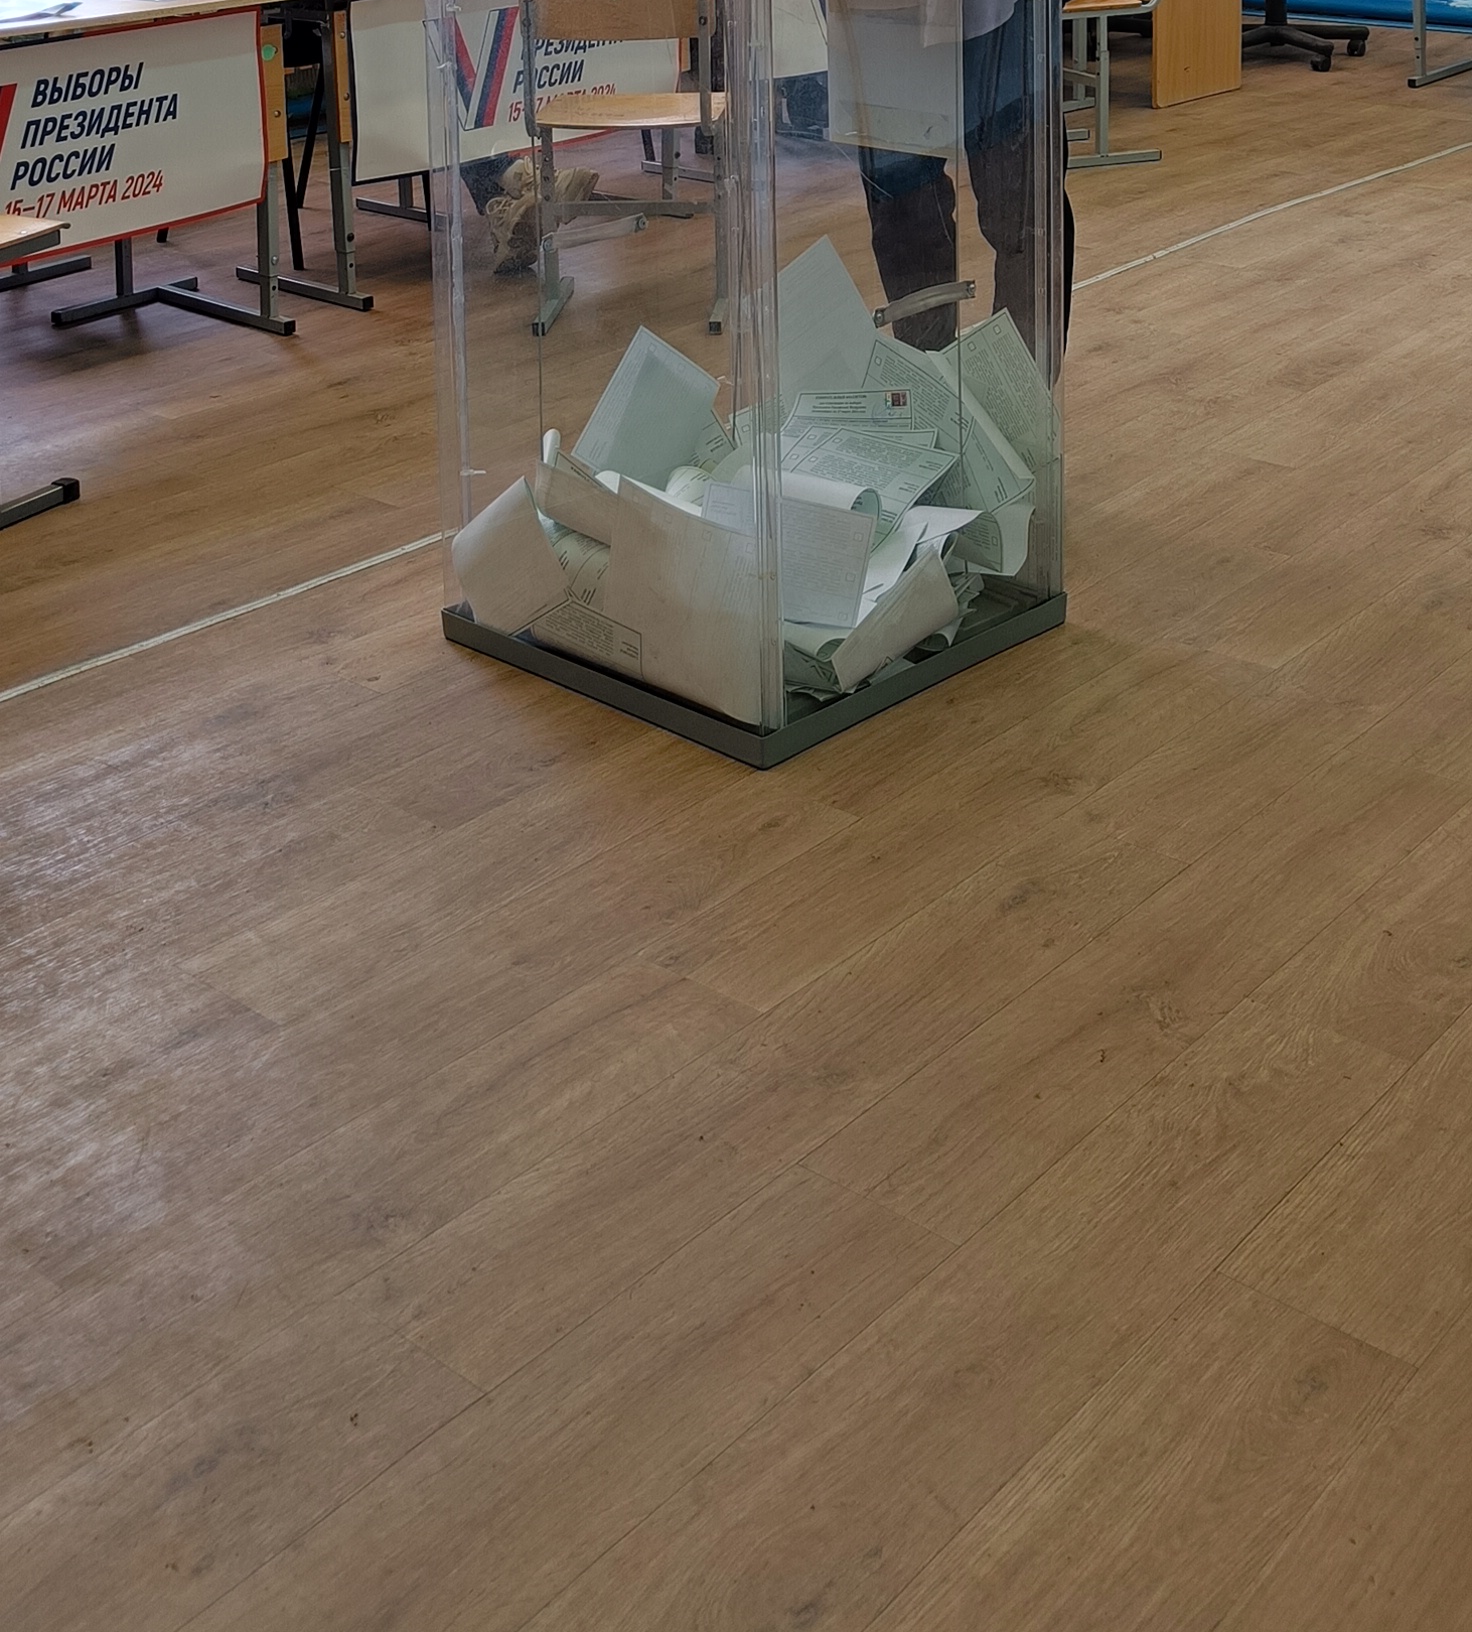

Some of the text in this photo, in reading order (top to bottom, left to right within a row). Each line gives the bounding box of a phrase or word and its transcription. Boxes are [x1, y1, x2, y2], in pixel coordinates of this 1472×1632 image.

[31, 62, 144, 108] ВЫБОРЫ
[513, 59, 584, 94] РССИИ
[20, 93, 179, 149] ПРЕЗИДЕНТА
[10, 143, 116, 191] РОССИИ
[56, 179, 118, 214] МАРТА
[121, 170, 163, 201] 2024
